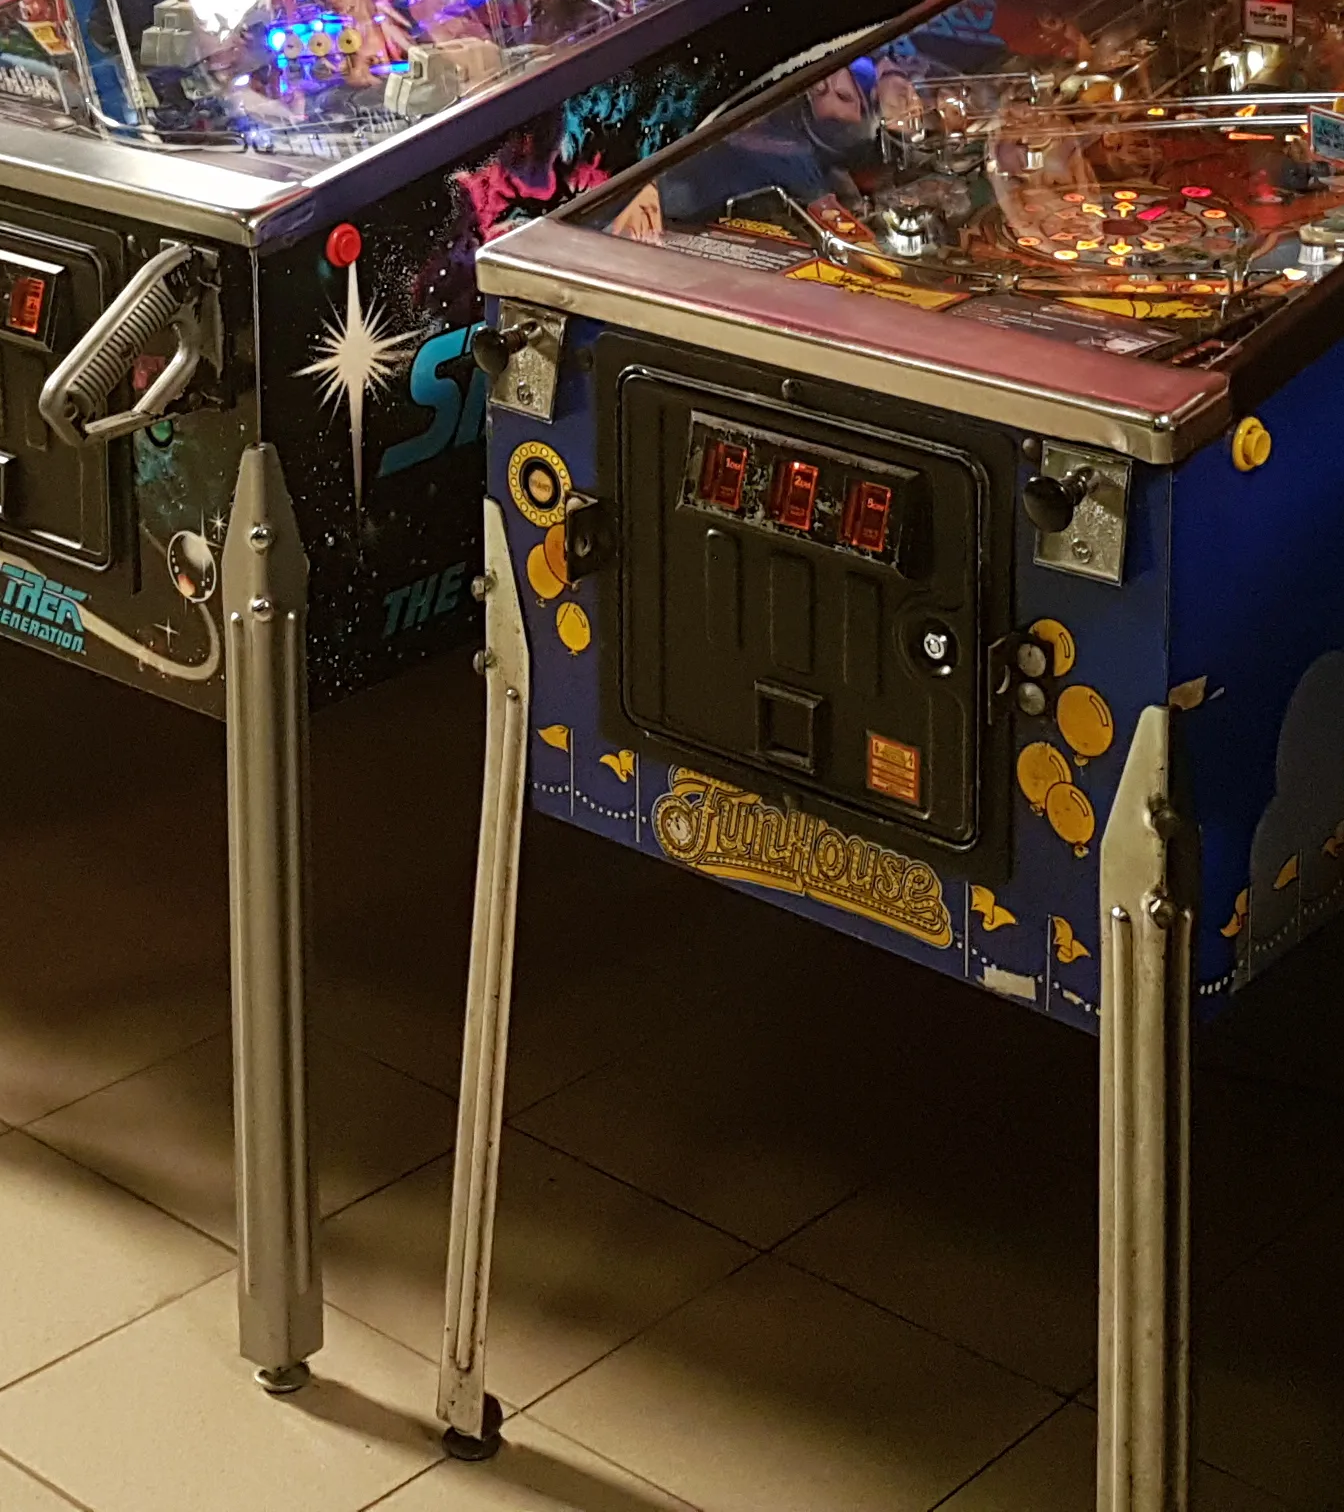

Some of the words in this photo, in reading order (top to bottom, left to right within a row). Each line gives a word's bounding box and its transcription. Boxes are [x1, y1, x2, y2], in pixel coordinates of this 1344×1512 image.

[2, 562, 88, 633] TREK
[382, 561, 466, 639] THE
[653, 764, 953, 949] FunHouse
